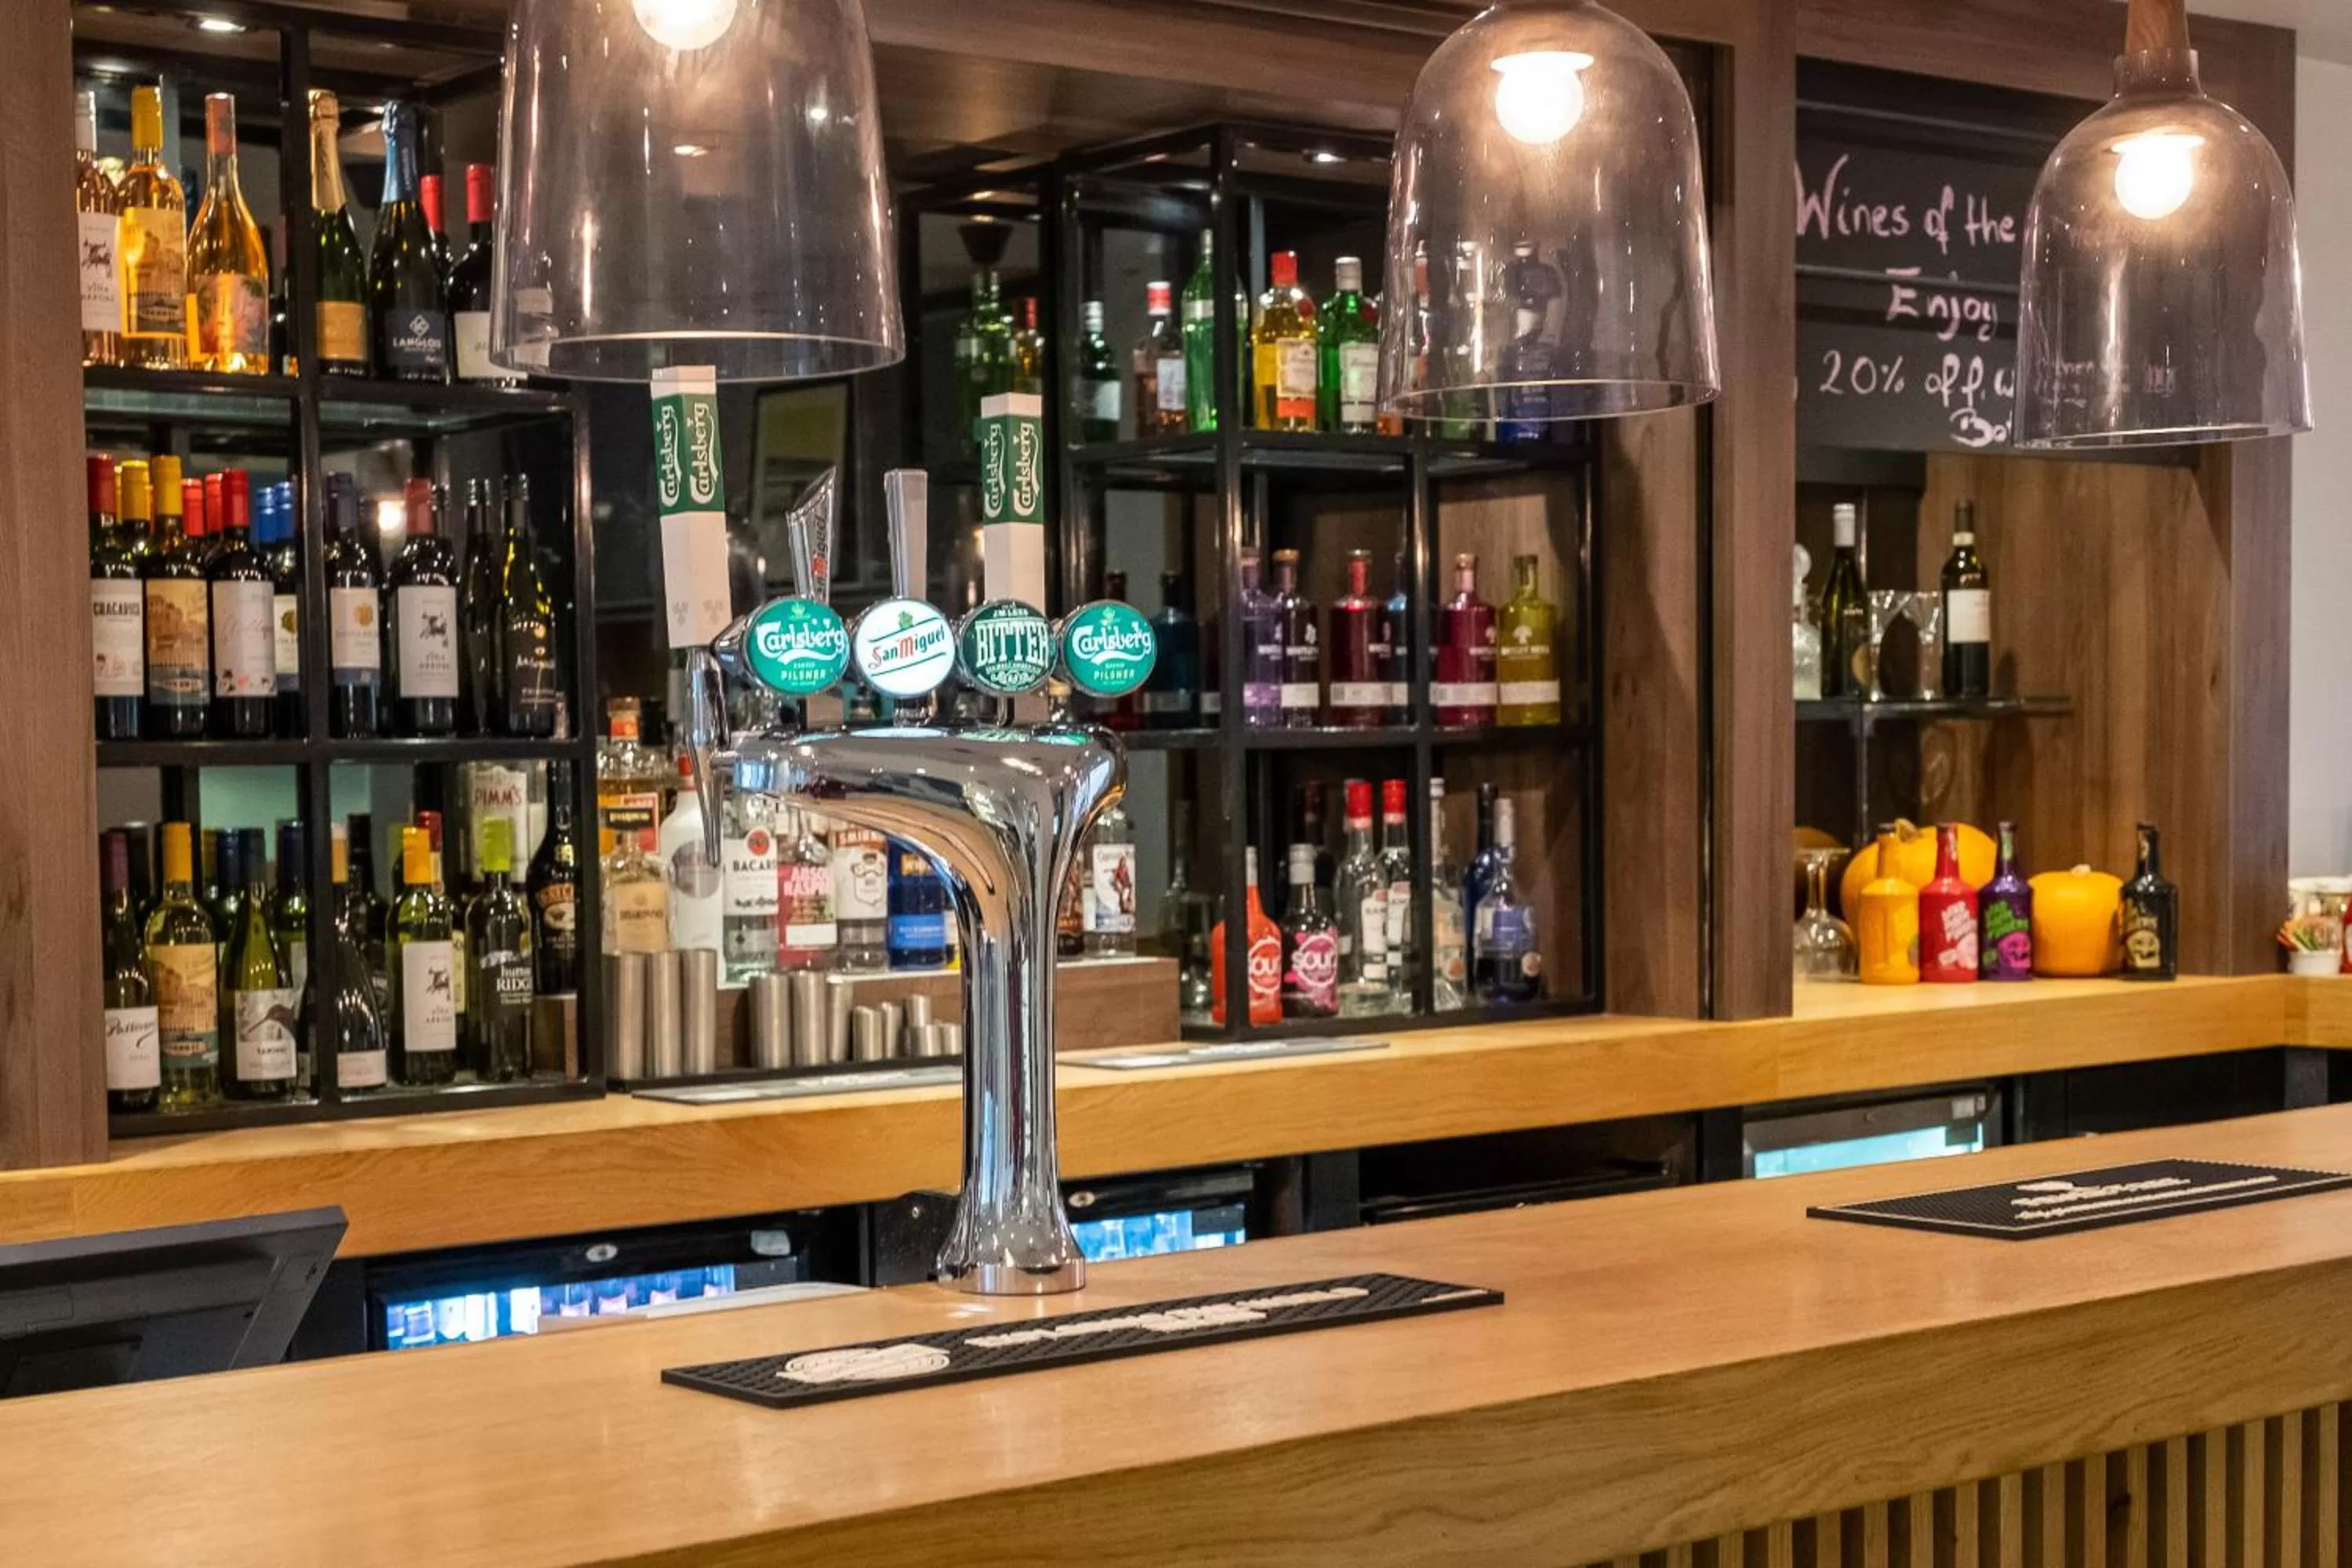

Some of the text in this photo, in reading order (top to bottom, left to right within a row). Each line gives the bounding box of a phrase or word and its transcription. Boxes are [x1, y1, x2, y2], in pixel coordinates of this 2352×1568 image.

[1794, 154, 2015, 256] Wines of the
[1885, 267, 1998, 343] Enjoy
[1819, 350, 1905, 394] 20%
[657, 405, 682, 506] Carlsberg
[687, 402, 719, 503] Carlsberg
[984, 423, 1006, 517] Carlsberg
[1013, 422, 1040, 516] Carlsberg
[756, 617, 846, 665] Carlsberg
[975, 620, 1048, 668] BITTER
[1072, 621, 1152, 666] Carlsberg
[780, 669, 826, 681] PILSNER
[1094, 668, 1134, 681] PILSNER
[474, 786, 522, 806] PIMM'S
